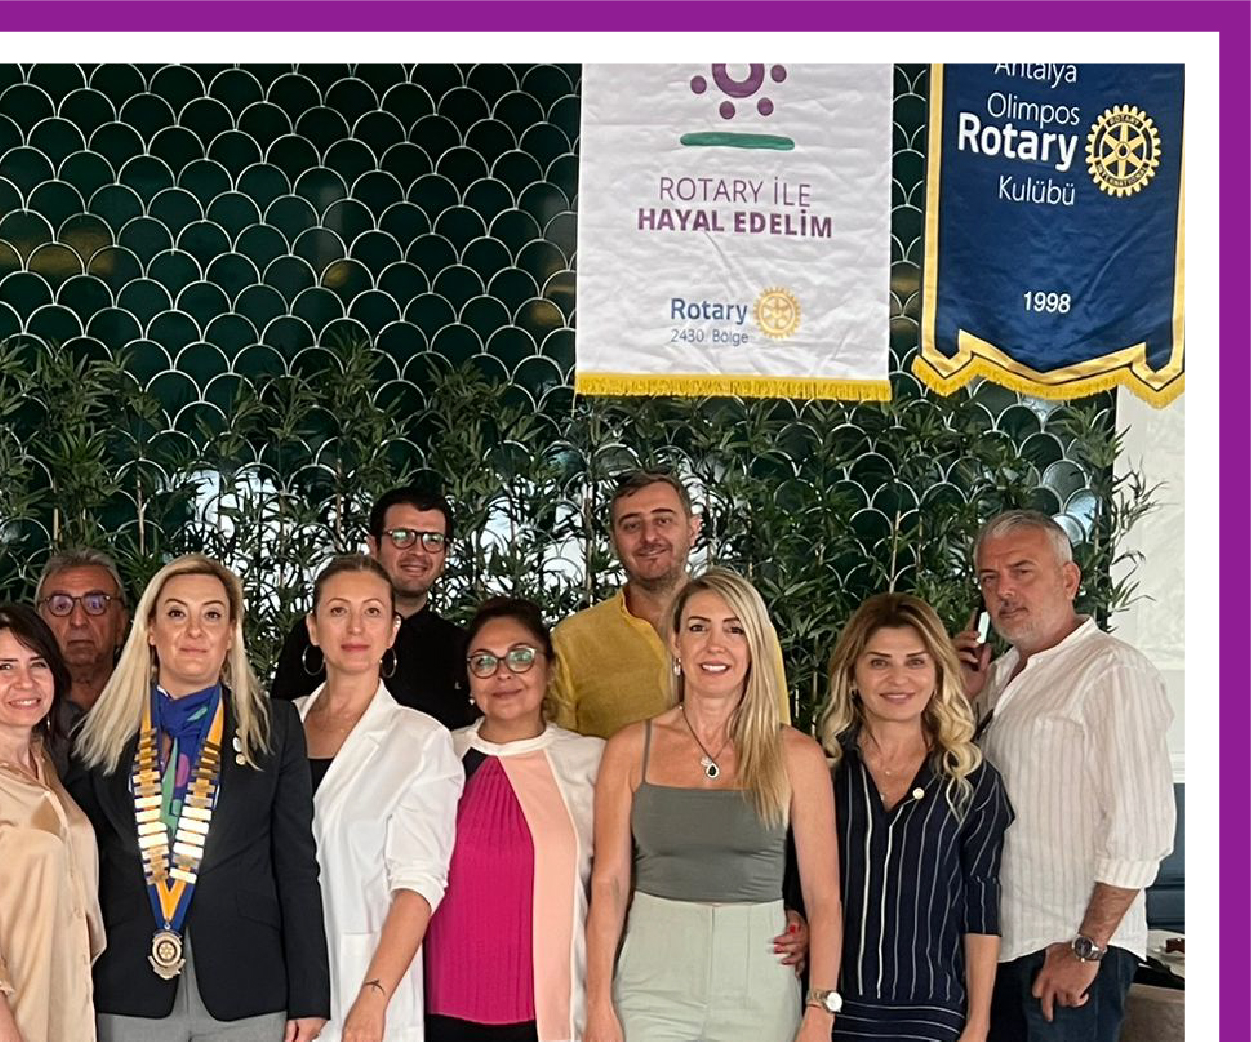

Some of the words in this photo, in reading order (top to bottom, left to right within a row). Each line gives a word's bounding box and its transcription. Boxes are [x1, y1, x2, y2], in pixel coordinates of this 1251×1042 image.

[987, 92, 1080, 128] Olimpos
[958, 111, 1078, 171] Rotary
[660, 177, 763, 204] ROTARY
[773, 176, 810, 207] İLE
[999, 175, 1076, 205] Kulübü
[637, 208, 724, 232] HAYAL
[733, 209, 832, 238] EDELİM
[670, 297, 748, 325] Rotary
[1023, 291, 1071, 313] 1998
[671, 328, 704, 342] 2430
